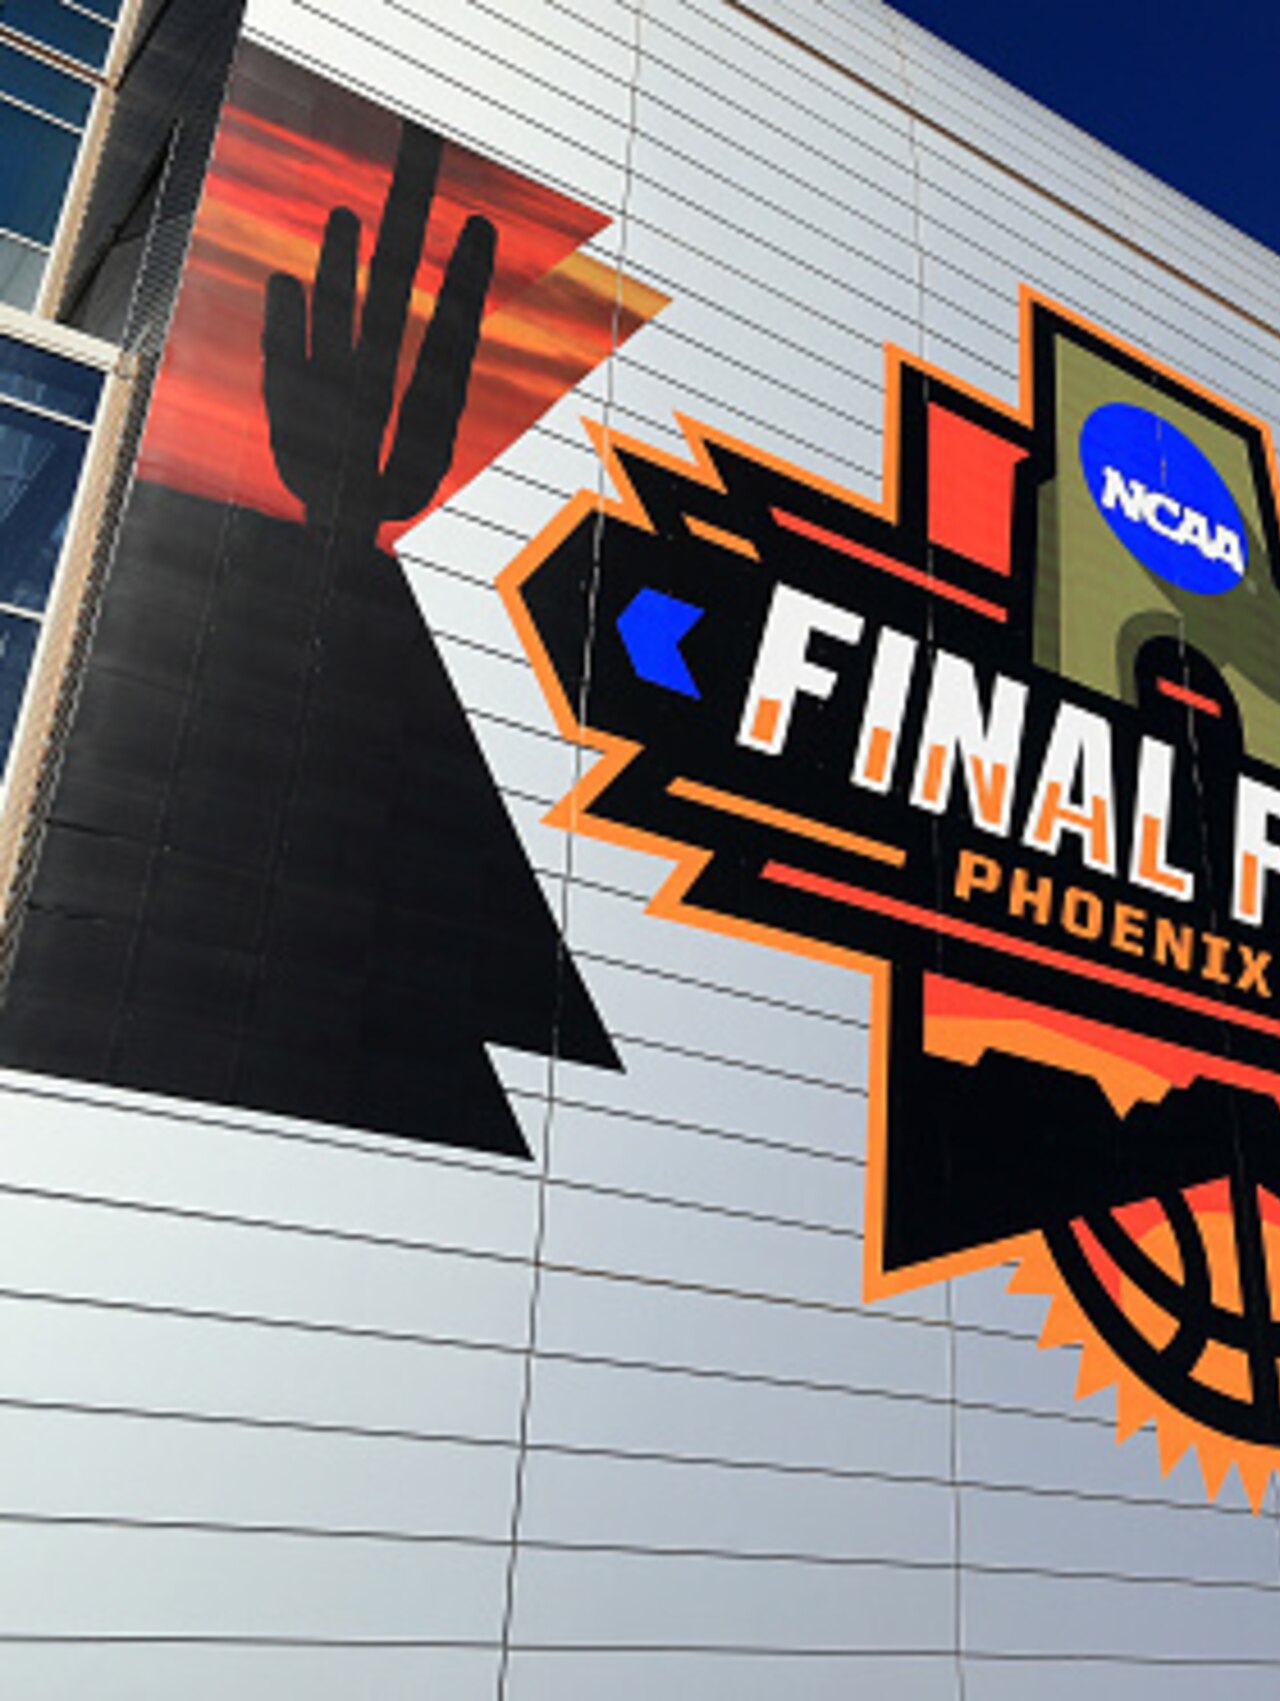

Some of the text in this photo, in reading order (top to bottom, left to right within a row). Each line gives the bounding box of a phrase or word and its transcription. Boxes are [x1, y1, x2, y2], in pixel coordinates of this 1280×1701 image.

[1101, 465, 1244, 577] NCAA
[736, 583, 1195, 903] FINAL
[954, 849, 1273, 998] PHOENIX
